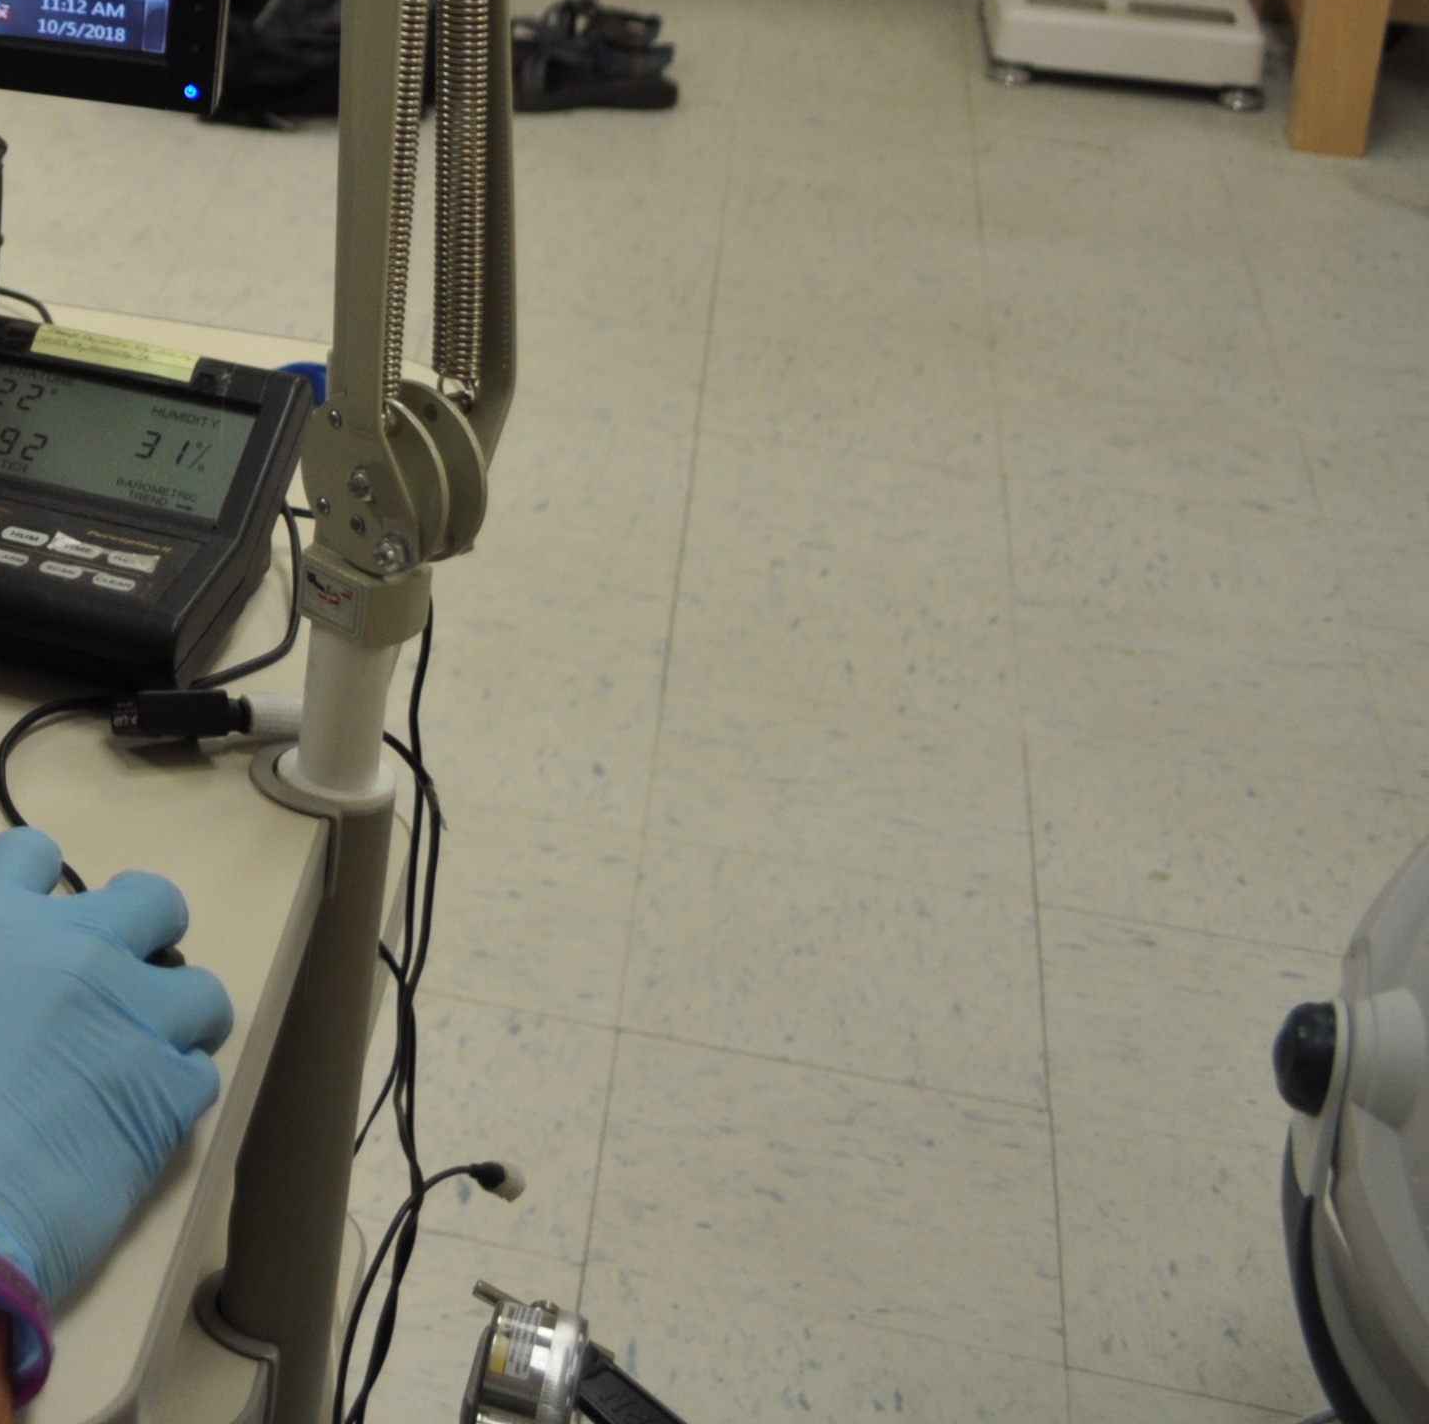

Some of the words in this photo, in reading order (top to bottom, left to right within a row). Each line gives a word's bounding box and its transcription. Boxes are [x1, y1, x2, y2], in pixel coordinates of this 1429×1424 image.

[91, 2, 125, 19] AM
[37, 18, 126, 42] 10/5/2018
[151, 405, 221, 429] HUMIDITY
[134, 429, 212, 472] 31%
[116, 476, 198, 503] BAROMETRIC
[127, 489, 168, 508] TREND
